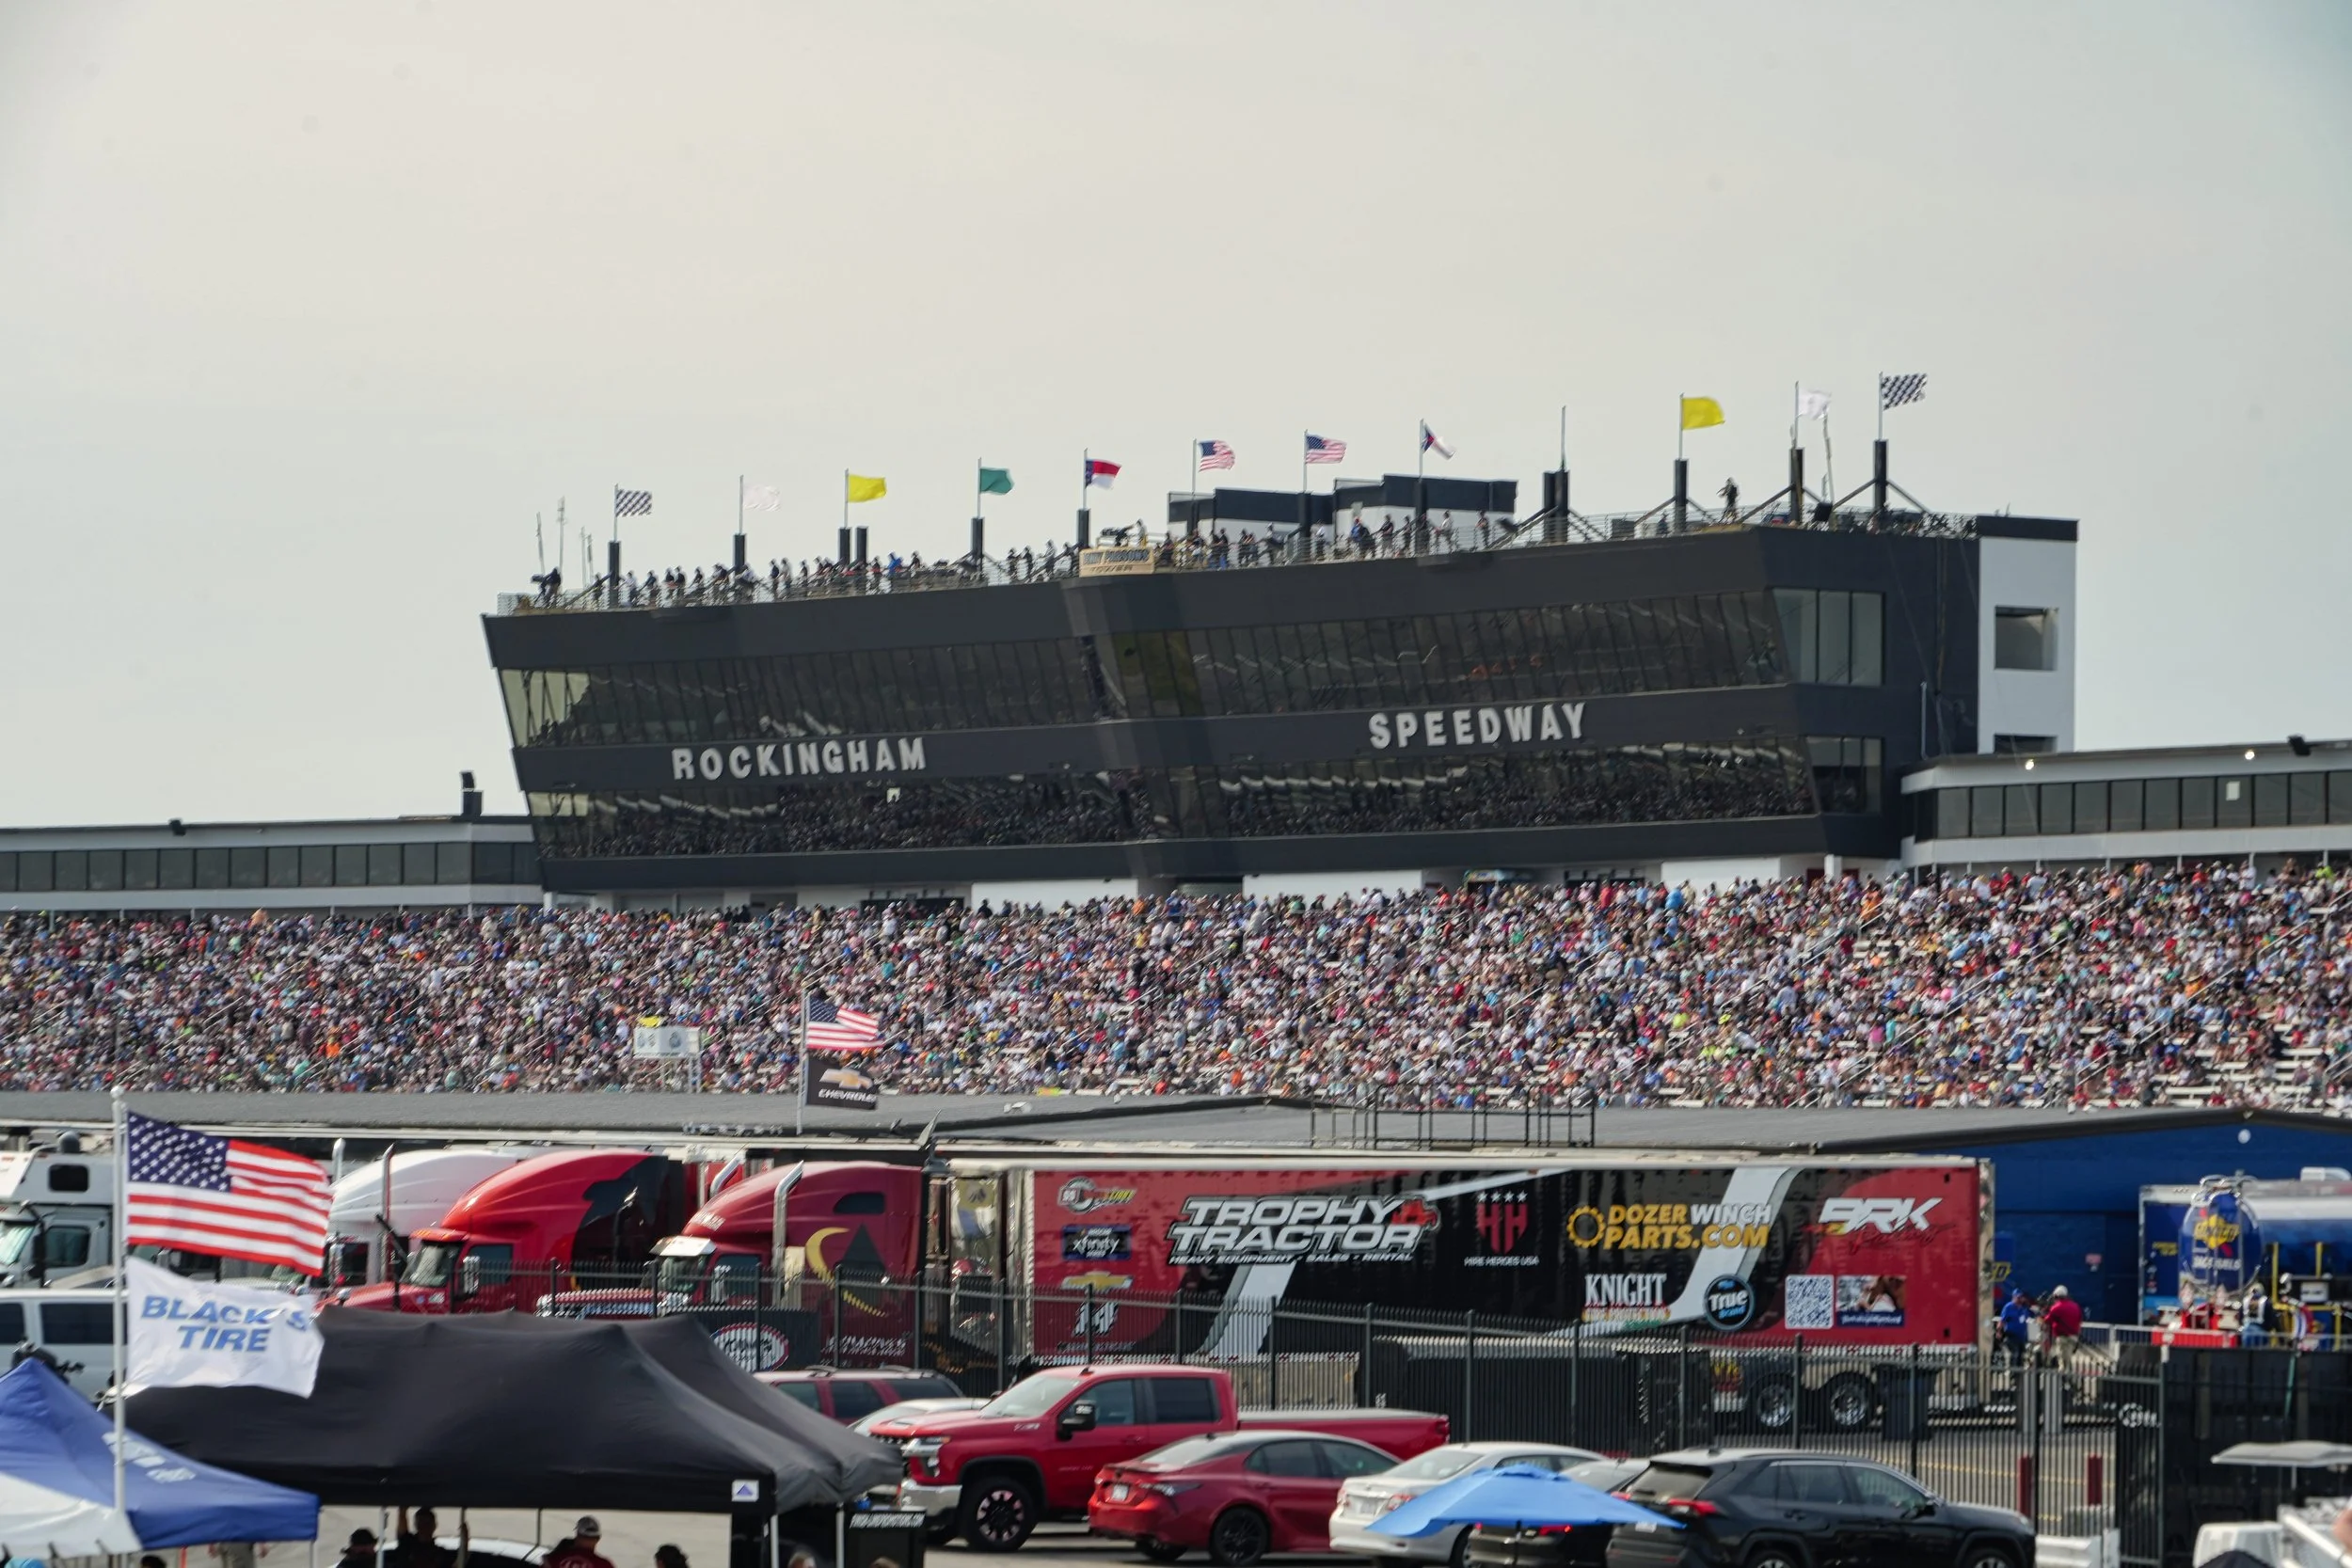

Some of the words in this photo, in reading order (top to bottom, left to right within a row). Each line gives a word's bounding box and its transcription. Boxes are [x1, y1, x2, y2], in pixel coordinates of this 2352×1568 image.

[1368, 702, 1585, 750] SPEEDWAY
[671, 736, 926, 781] ROCKINGHAM
[1186, 1199, 1405, 1227] TROPHY
[1608, 1203, 1687, 1225] DOZER
[1691, 1203, 1772, 1225] WINCH
[1172, 1224, 1421, 1252] TRACTOR
[1603, 1224, 1771, 1250] PARTS.COM
[1168, 1255, 1214, 1264] HEAVY
[1216, 1254, 1294, 1264] EQUIPMENT
[1305, 1254, 1349, 1262] SALES
[1361, 1253, 1413, 1262] RENTAL
[1520, 1256, 1540, 1266] USA
[1584, 1273, 1667, 1307] KNIGHT
[1708, 1290, 1748, 1312] True
[177, 1325, 271, 1352] TIRE
